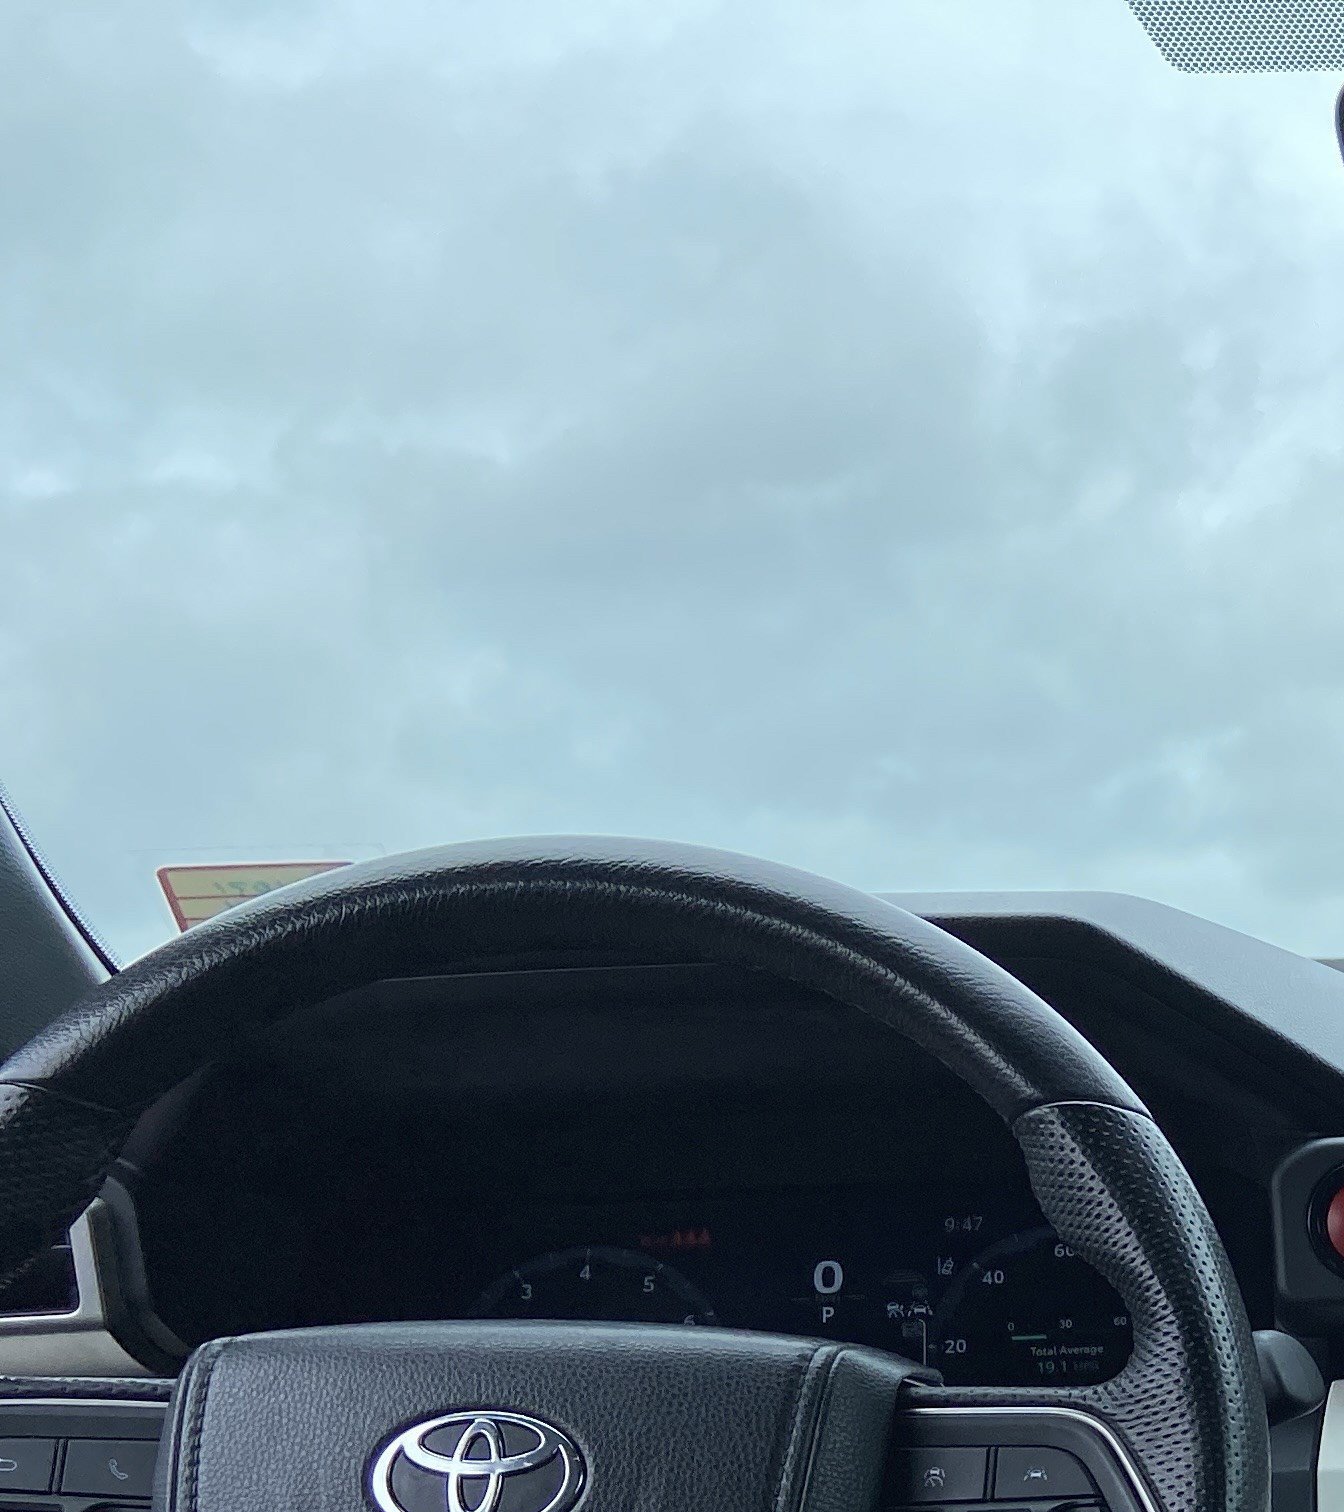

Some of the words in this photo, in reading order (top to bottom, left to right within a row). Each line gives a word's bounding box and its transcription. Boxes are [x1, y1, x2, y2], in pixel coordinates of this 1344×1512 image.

[944, 1216, 984, 1233] 9:47
[579, 1264, 591, 1281] 4
[814, 1260, 843, 1294] 0
[982, 1270, 1005, 1285] 40
[521, 1284, 532, 1300] 3
[642, 1276, 655, 1293] 5
[822, 1306, 835, 1323] P
[1113, 1316, 1127, 1326] 60
[1059, 1319, 1073, 1329] 30
[944, 1339, 967, 1354] 20
[1030, 1347, 1057, 1357] Total
[1059, 1345, 1104, 1357] Average
